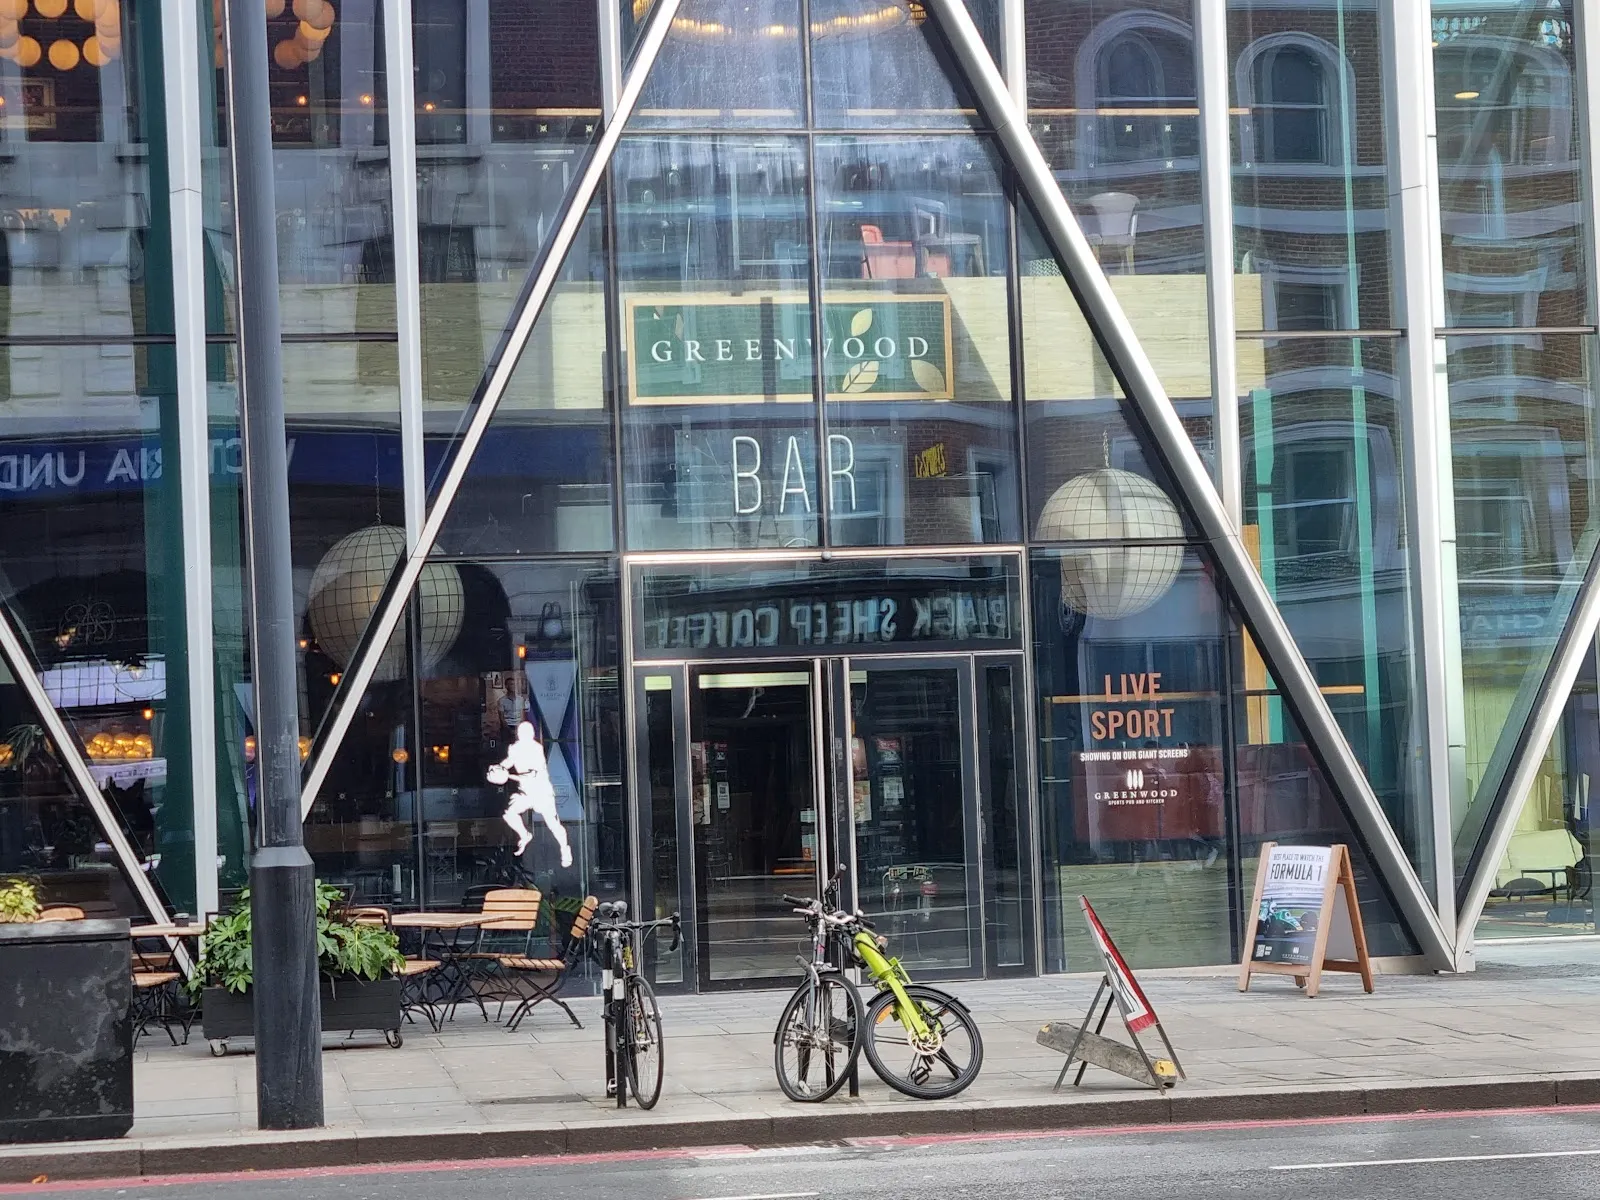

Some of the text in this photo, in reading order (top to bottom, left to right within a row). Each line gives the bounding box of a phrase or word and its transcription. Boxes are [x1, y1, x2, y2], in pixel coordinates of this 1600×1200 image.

[732, 434, 857, 514] BAR
[1104, 672, 1163, 703] LIVE
[1091, 708, 1175, 740] SPORT
[1080, 749, 1188, 762] SHOWING ON OUR GIANT SCREENS
[1094, 789, 1178, 800] GREENWOOD
[1270, 863, 1323, 882] FORMULA 1
